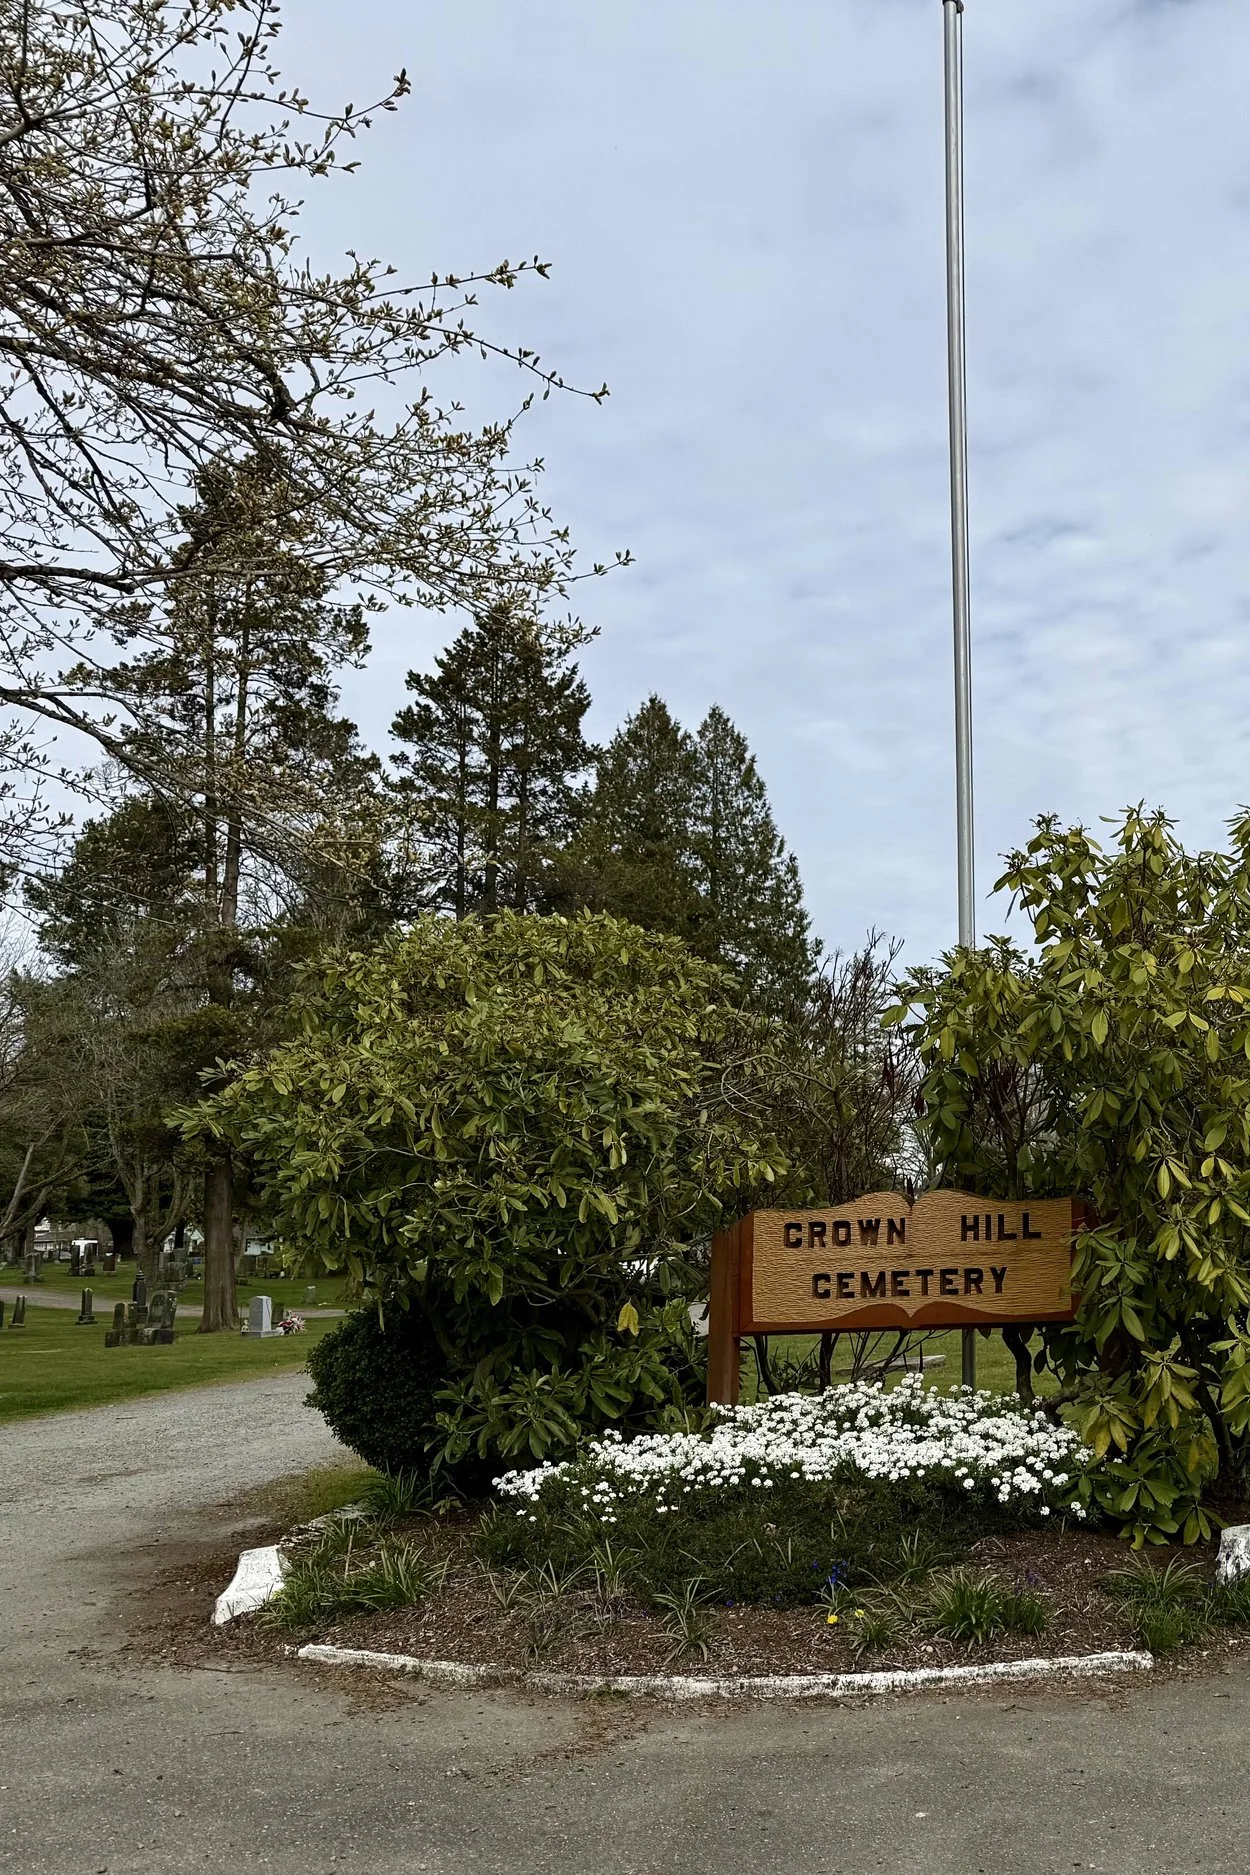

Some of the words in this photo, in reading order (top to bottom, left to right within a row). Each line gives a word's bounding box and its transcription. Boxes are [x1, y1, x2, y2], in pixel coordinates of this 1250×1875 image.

[783, 1217, 906, 1249] CROWN
[960, 1212, 1042, 1242] HILL
[811, 1266, 1008, 1300] CEMETERY
